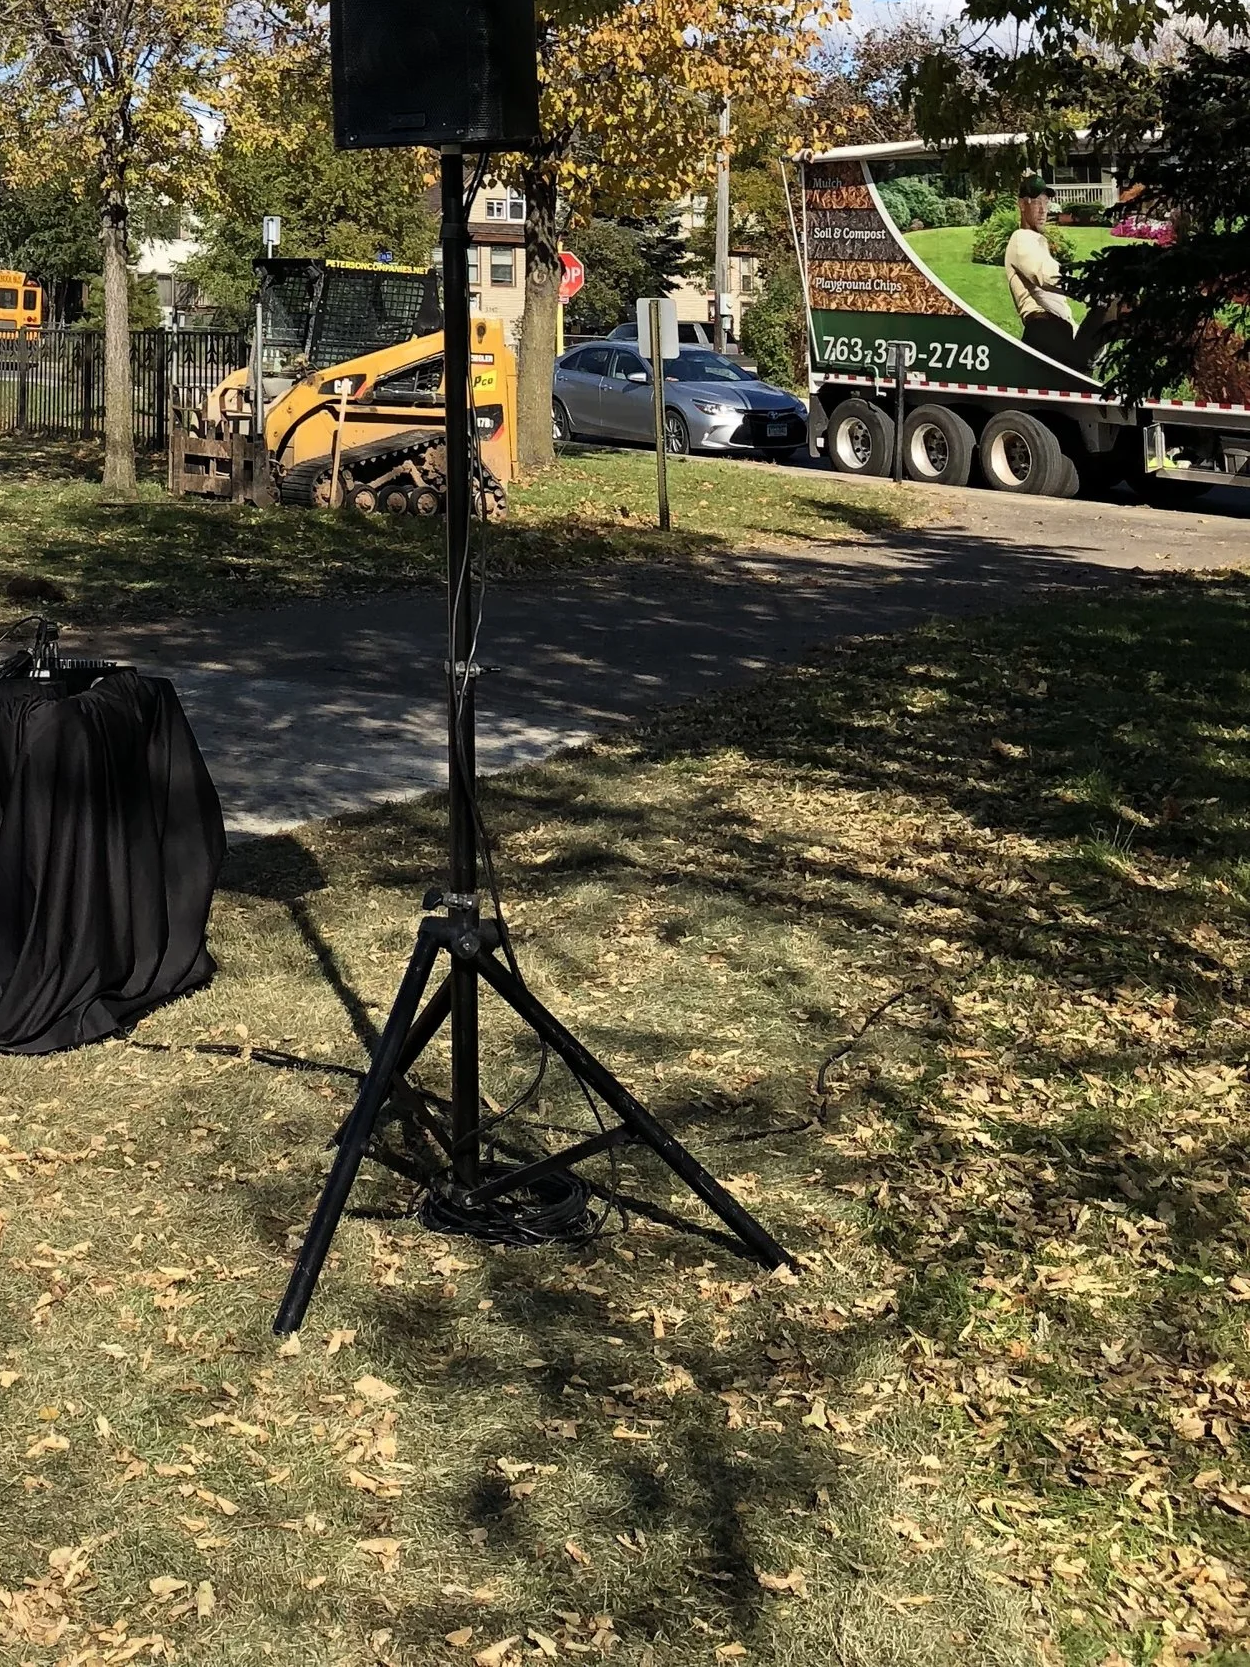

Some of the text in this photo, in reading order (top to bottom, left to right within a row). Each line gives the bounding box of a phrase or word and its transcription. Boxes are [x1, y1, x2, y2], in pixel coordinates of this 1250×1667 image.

[812, 177, 842, 189] Mulch
[813, 227, 886, 242] Soil & Compost
[325, 259, 430, 275] PETERSONCOMPANIES.NET
[561, 266, 581, 283] OP
[815, 277, 902, 294] Playground Chips
[334, 378, 353, 394] CT
